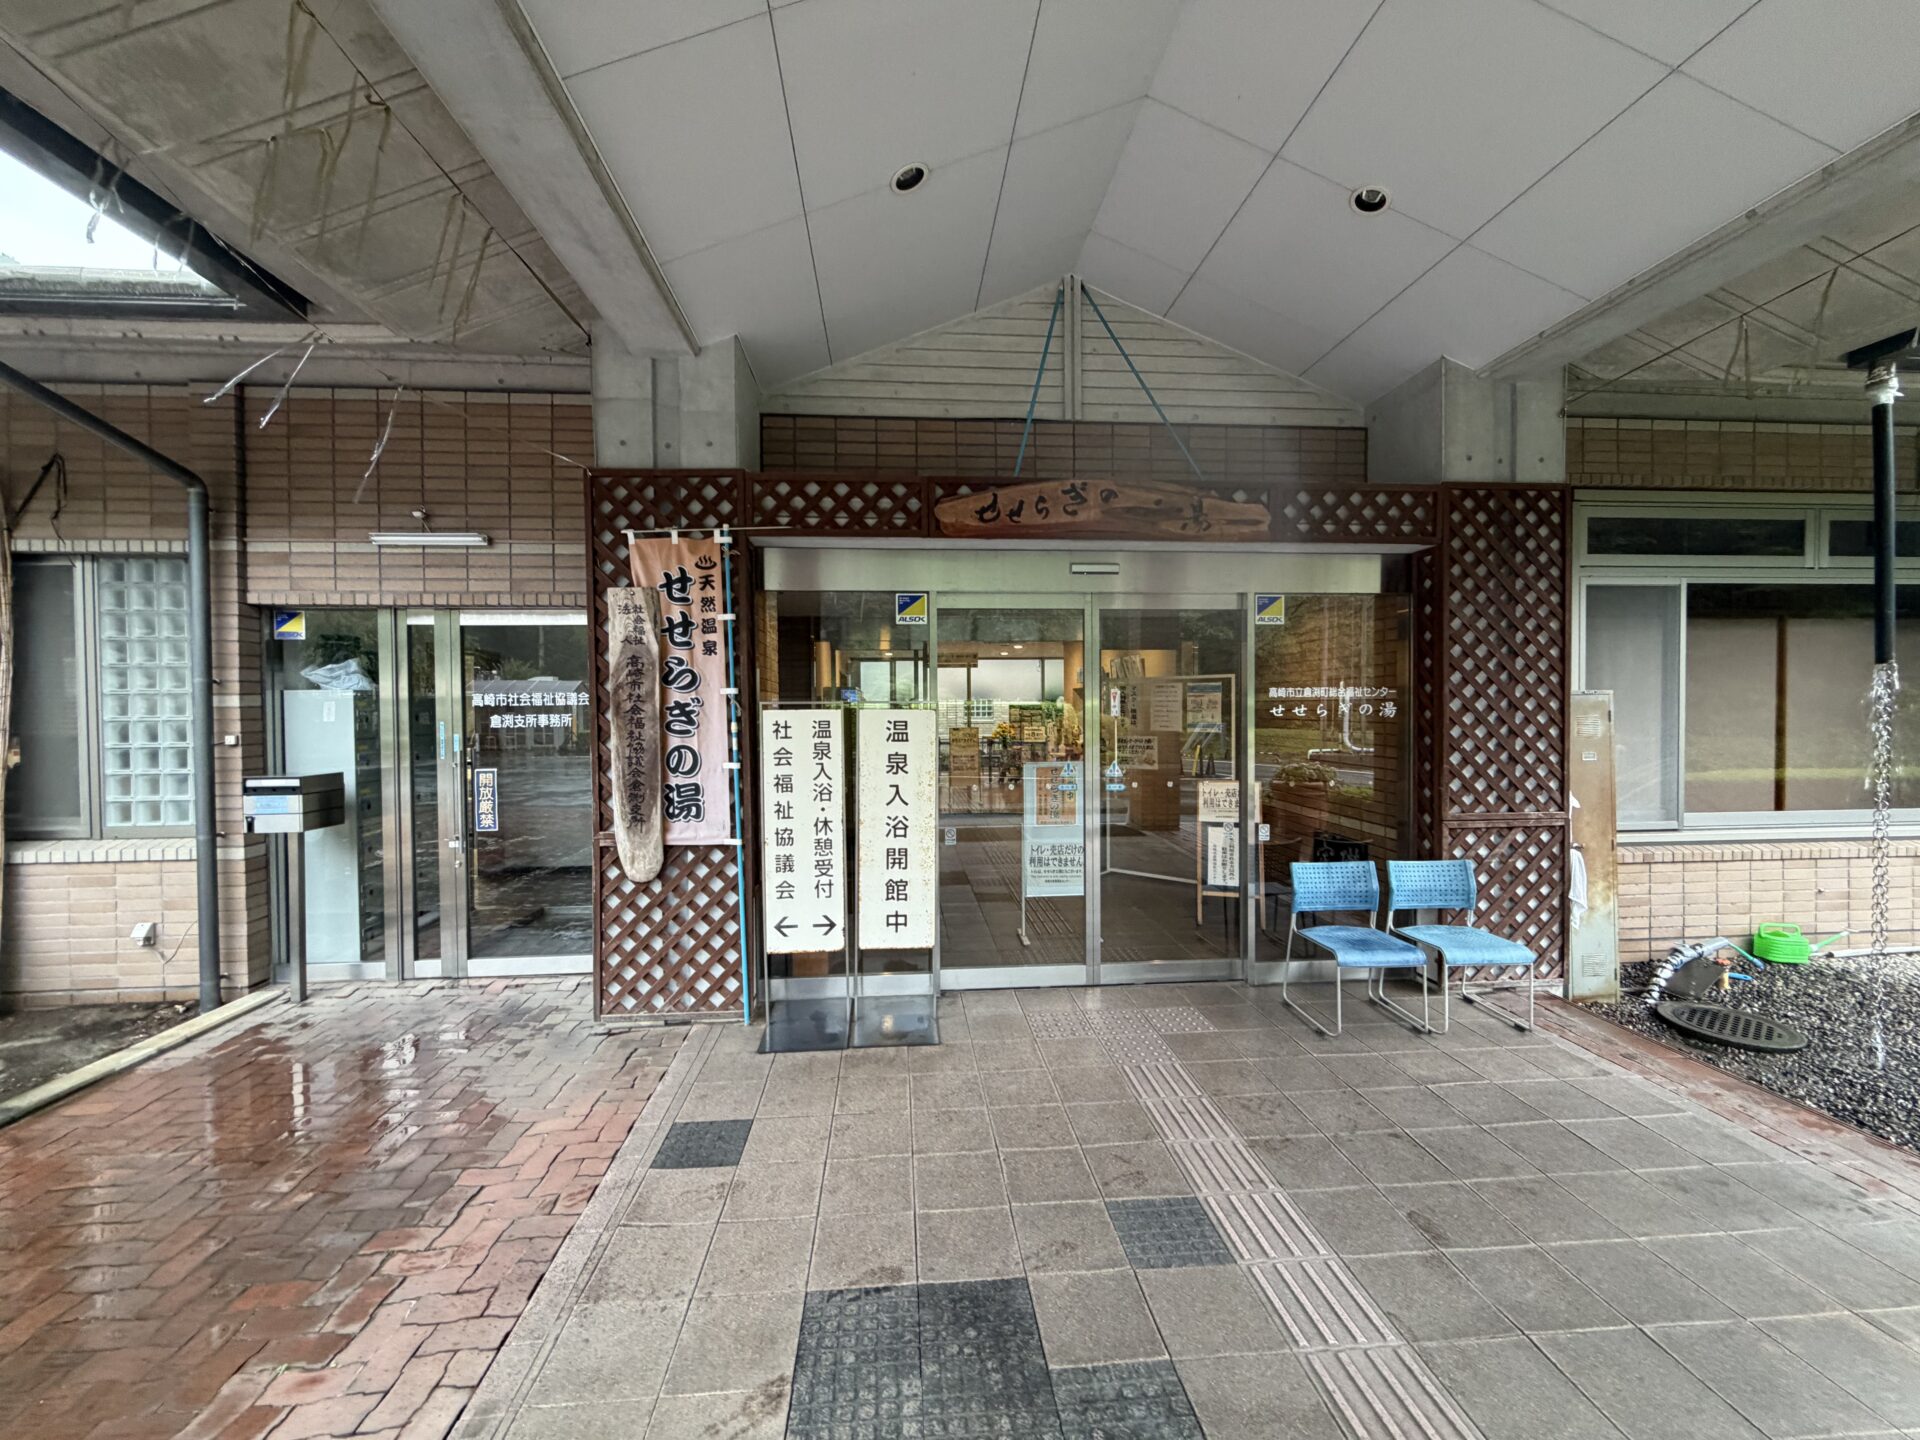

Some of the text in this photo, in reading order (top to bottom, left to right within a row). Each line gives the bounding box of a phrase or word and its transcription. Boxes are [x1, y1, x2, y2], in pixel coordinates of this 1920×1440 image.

[699, 572, 718, 656] 天然温泉
[472, 692, 590, 707] 高崎市社会福祉協議会
[658, 566, 705, 822] せせらぎの湯
[1269, 701, 1397, 718] せせらぎの湯
[478, 772, 495, 828] 開放厳禁
[772, 720, 795, 900] 社会福祉協議会
[812, 720, 834, 899] 温泉入浴・休憩受付
[885, 719, 909, 933] 温泉入浴開館中
[1202, 788, 1239, 798] トイレ・売店
